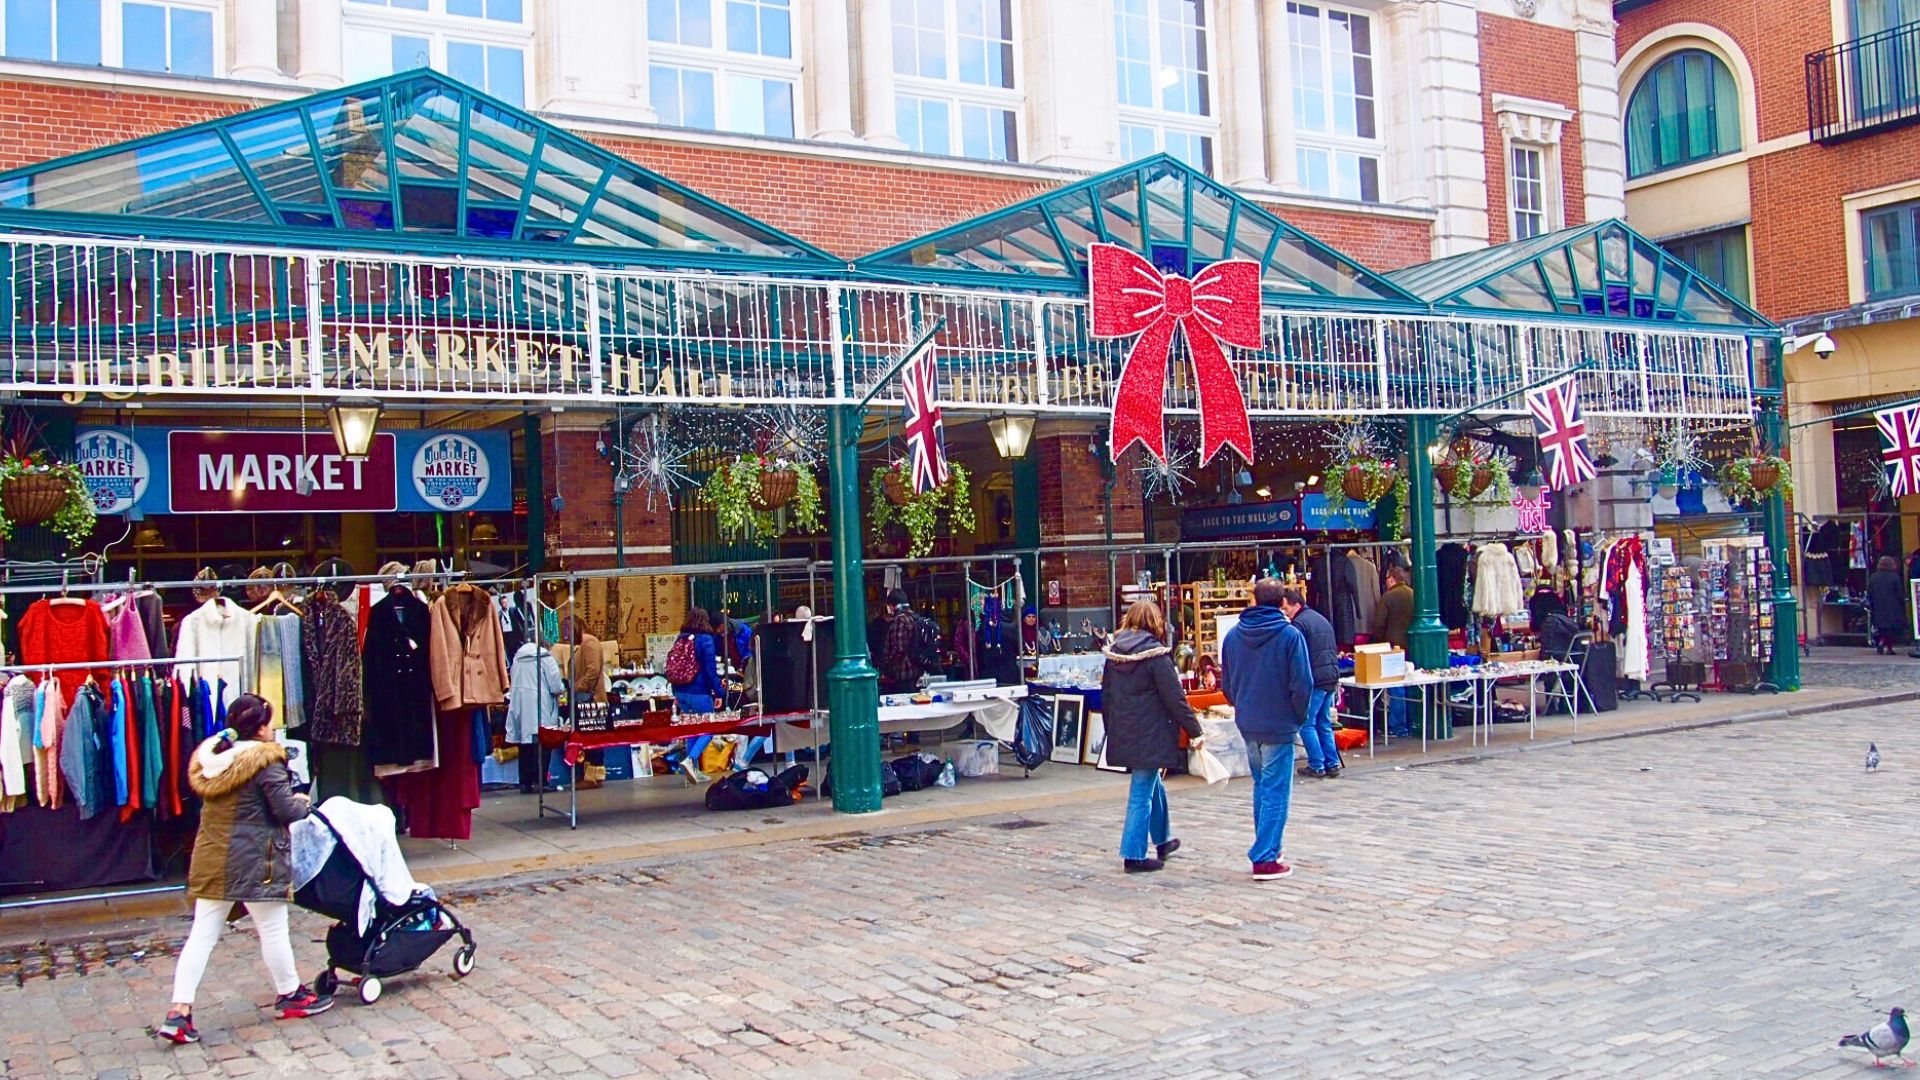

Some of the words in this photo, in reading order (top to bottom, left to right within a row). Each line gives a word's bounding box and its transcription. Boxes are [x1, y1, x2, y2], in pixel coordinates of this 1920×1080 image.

[345, 331, 583, 383] MARKET
[426, 451, 477, 464] JUBILEE
[198, 454, 368, 491] MARKET
[425, 461, 478, 476] MARKET
[1248, 513, 1267, 523] WALL
